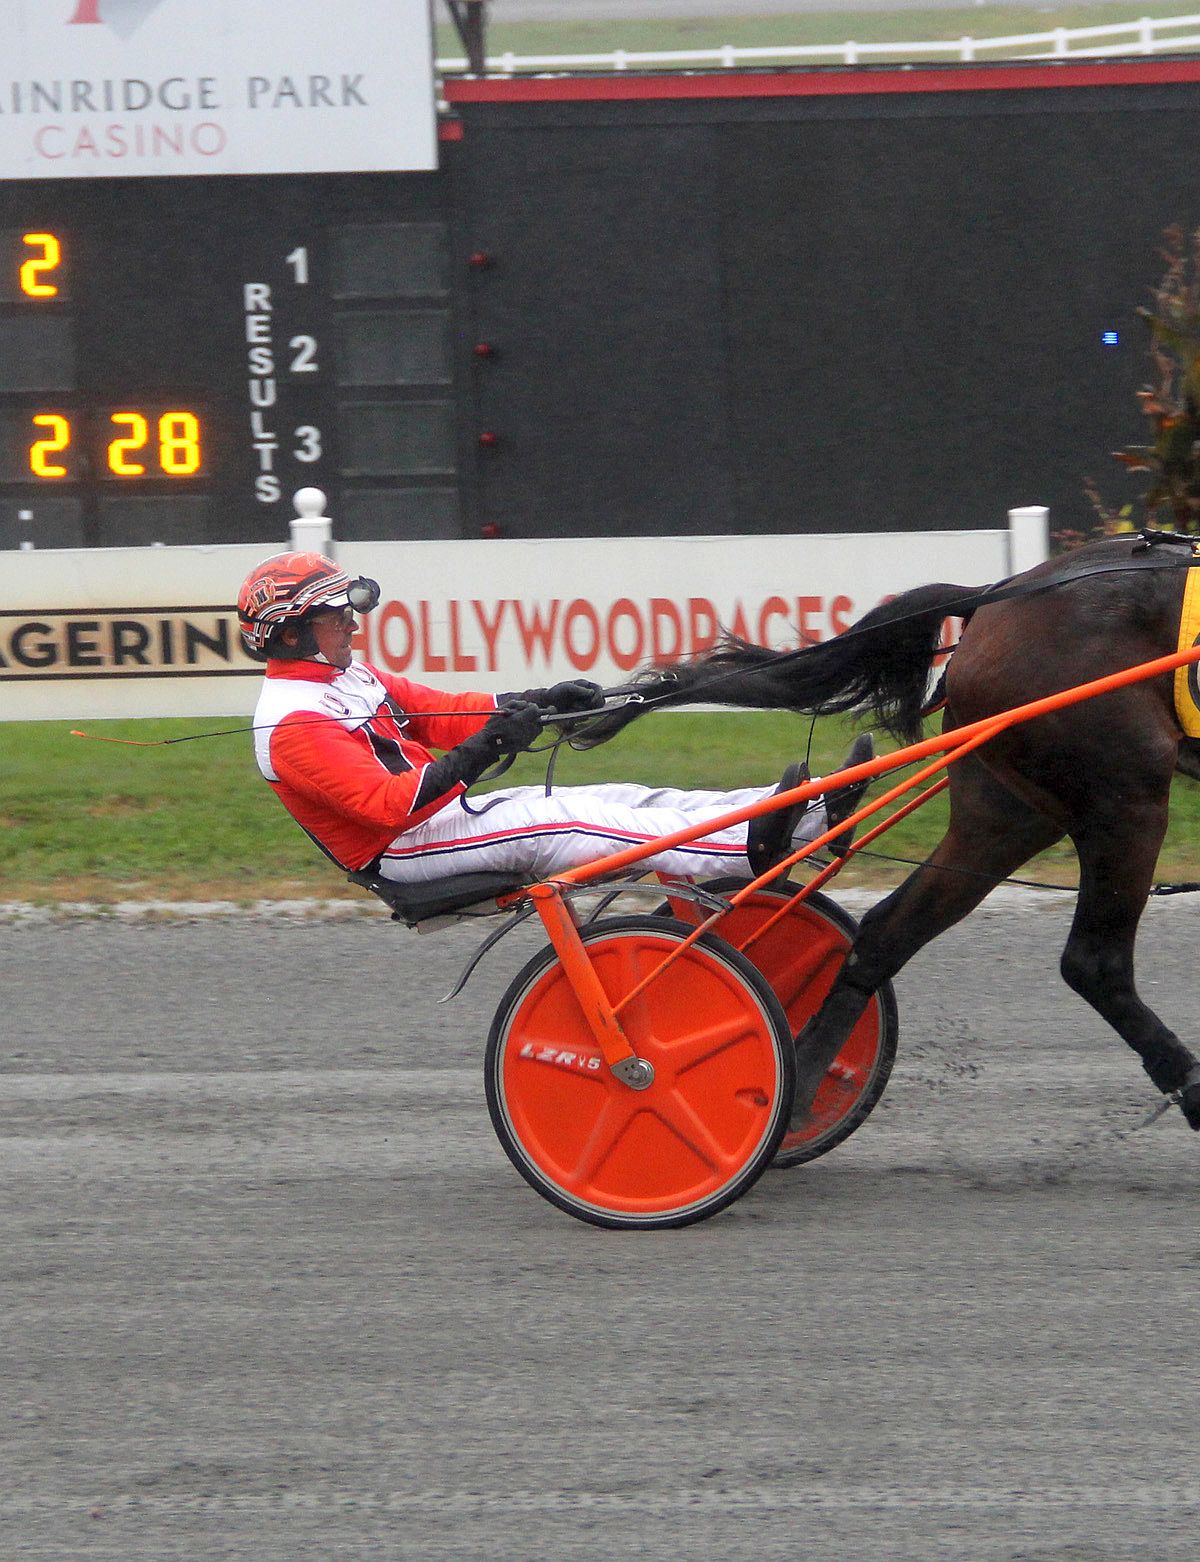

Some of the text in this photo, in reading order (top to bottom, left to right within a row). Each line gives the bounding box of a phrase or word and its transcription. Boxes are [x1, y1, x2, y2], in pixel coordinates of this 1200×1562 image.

[0, 74, 369, 114] INRIDGE PARK
[33, 122, 228, 160] CASINO
[19, 232, 61, 298] 2
[285, 247, 309, 284] 1
[289, 335, 319, 372] 2
[243, 282, 281, 503] RESULTS
[29, 411, 201, 477] 2 28
[293, 425, 322, 462] 3
[0, 619, 266, 669] GERIN
